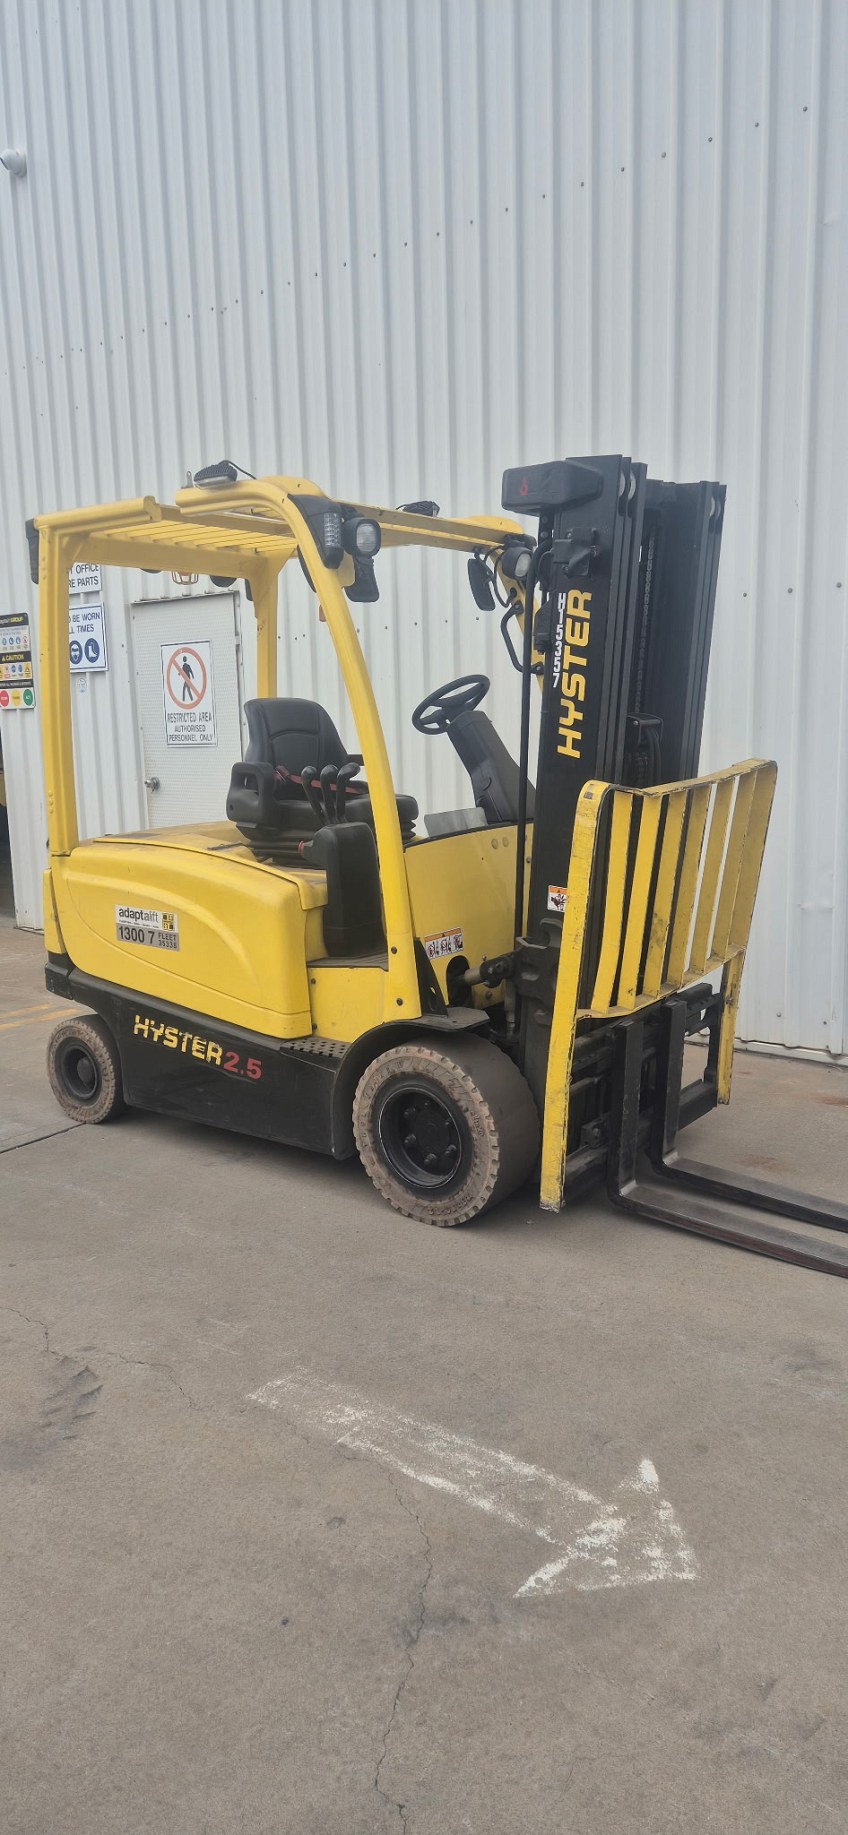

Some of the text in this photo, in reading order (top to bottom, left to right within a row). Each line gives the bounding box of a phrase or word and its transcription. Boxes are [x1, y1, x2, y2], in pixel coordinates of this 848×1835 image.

[76, 563, 99, 574] OFFICE
[77, 576, 99, 587] PARTS
[72, 614, 80, 623] BE
[82, 612, 100, 621] WORN
[77, 624, 94, 633] TIMES
[552, 593, 567, 688] H15357
[557, 589, 592, 758] HYSTER
[167, 711, 212, 723] RESTRICTED AREA
[174, 724, 206, 733] AUTHORISED
[169, 733, 213, 742] PERSONNEL ONLY
[118, 907, 159, 923] adaptalift
[118, 926, 155, 944] 1300 7
[158, 932, 176, 941] FLEET
[133, 1014, 262, 1080] HYSTER 2.5
